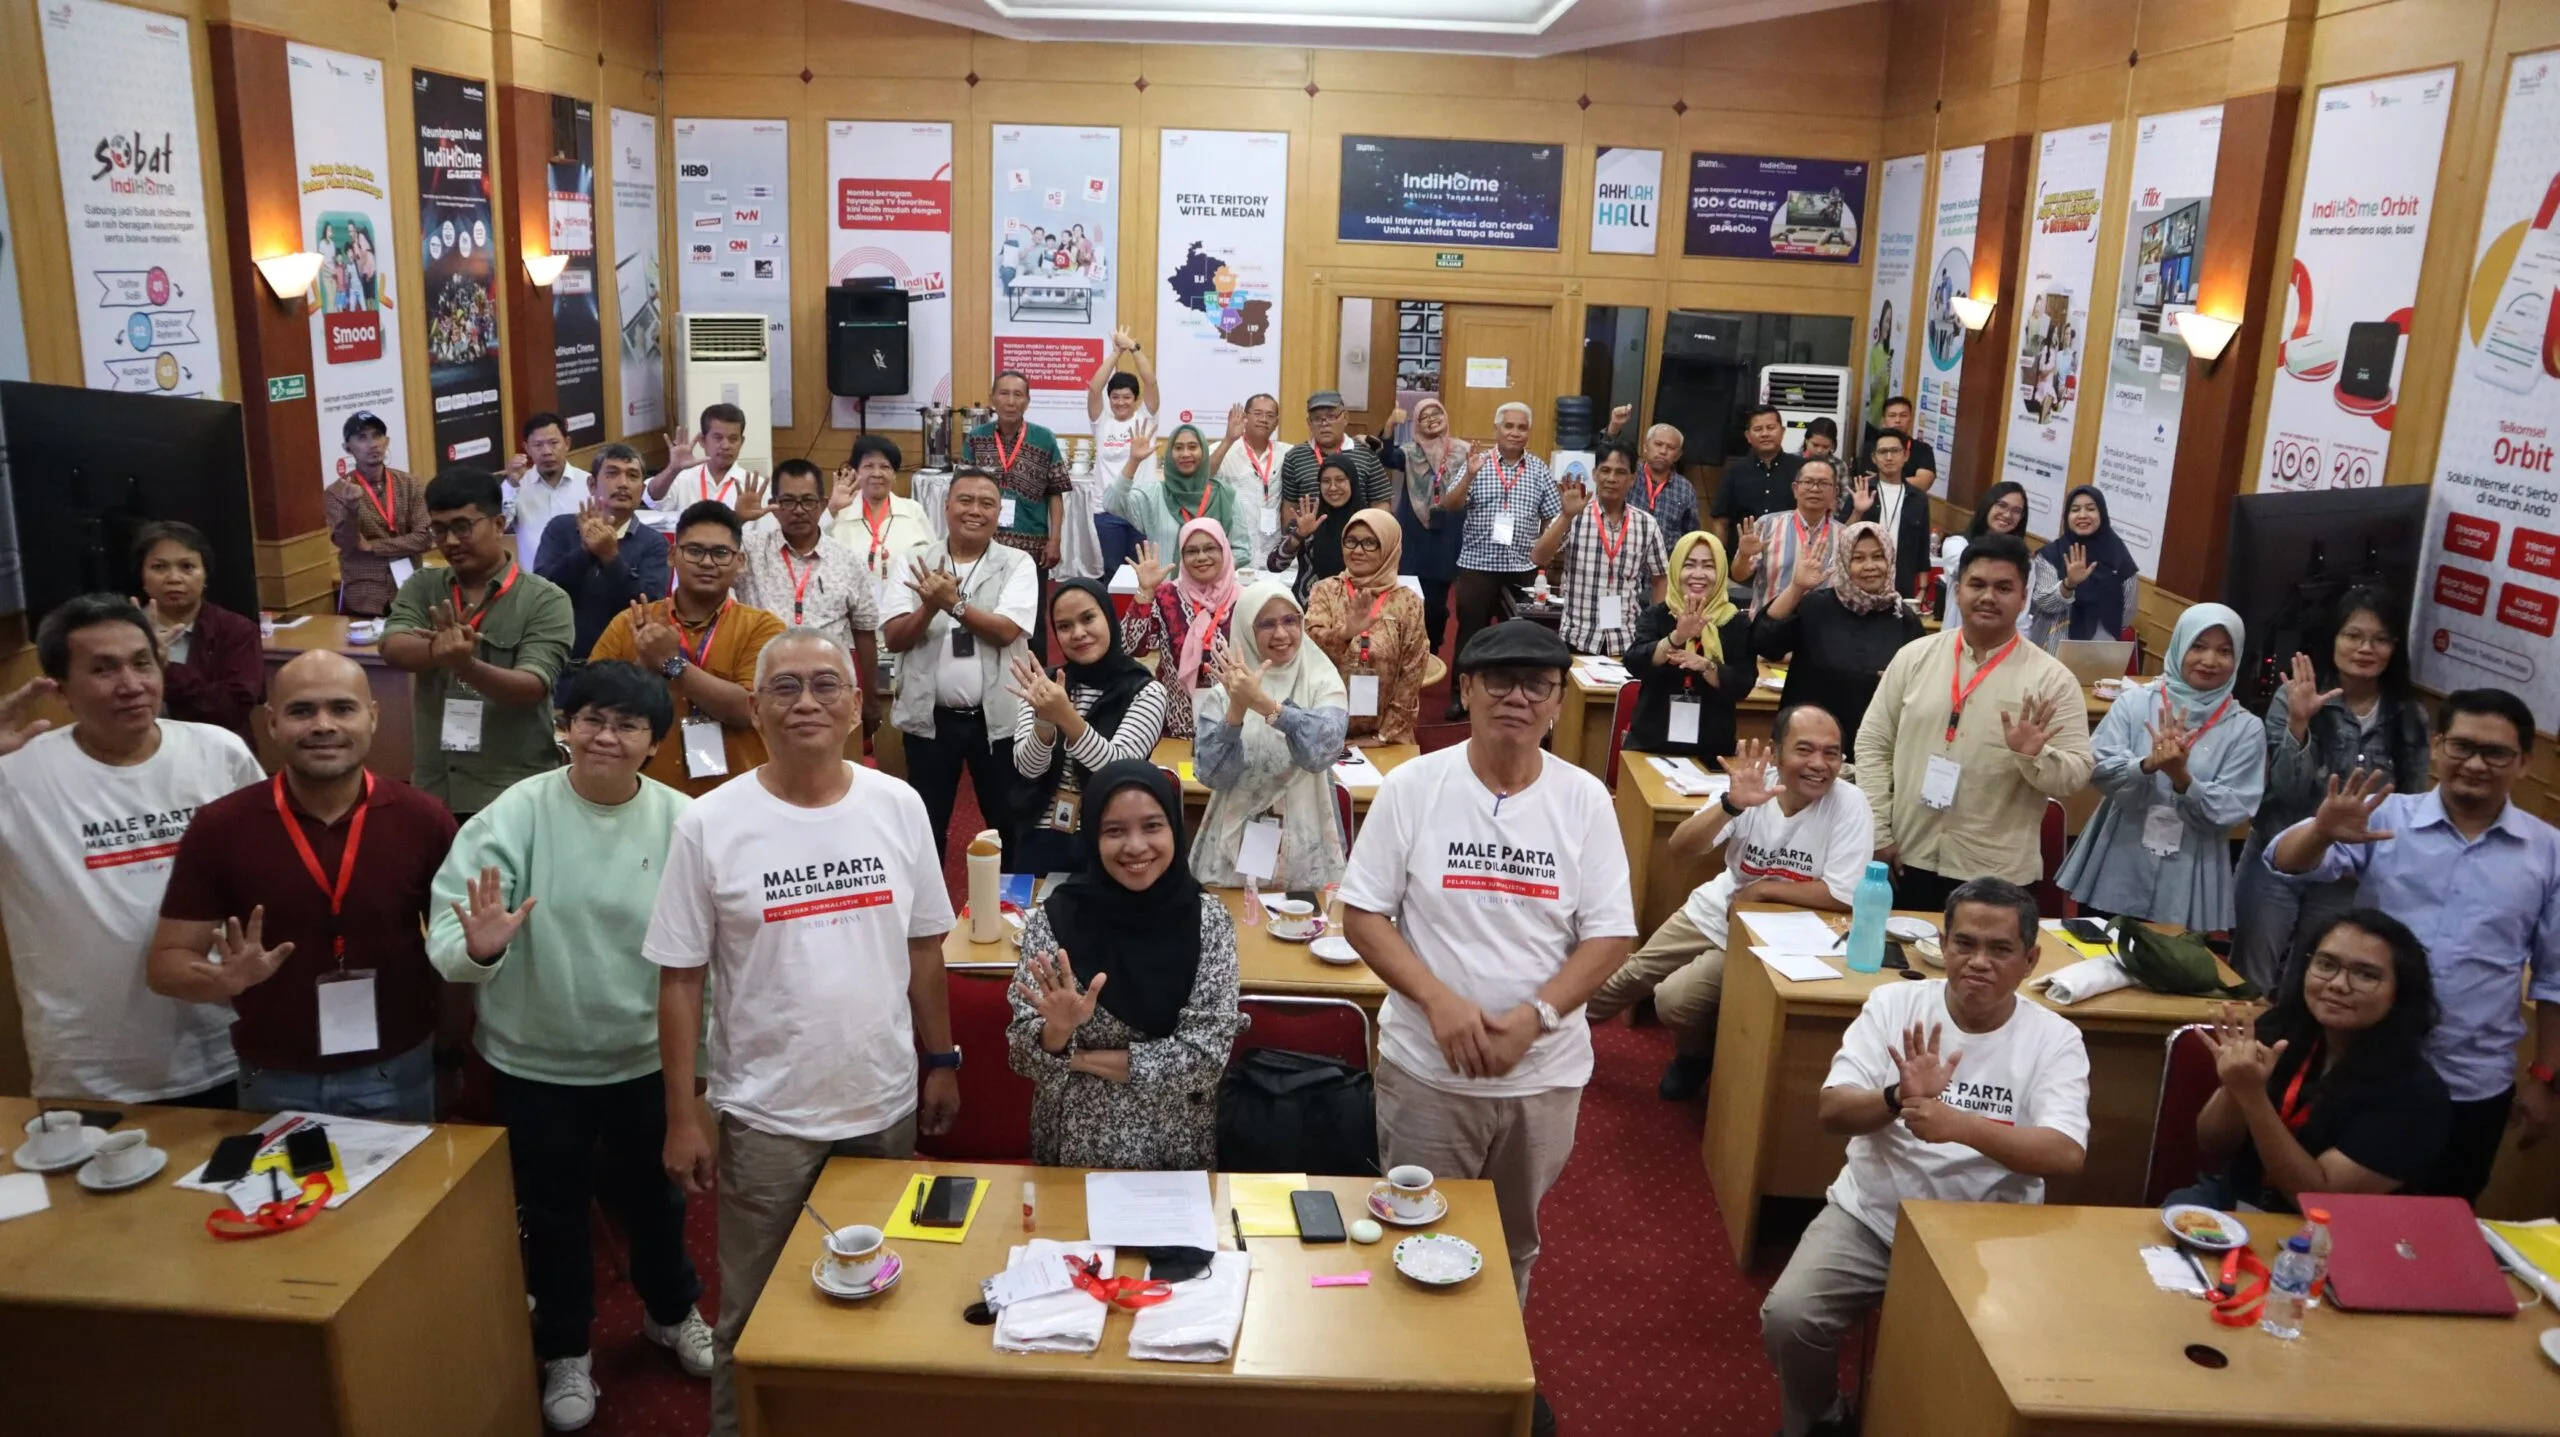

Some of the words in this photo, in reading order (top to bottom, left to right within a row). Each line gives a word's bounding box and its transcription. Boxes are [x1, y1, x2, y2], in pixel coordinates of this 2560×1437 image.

[421, 126, 463, 141] Keuntungan
[464, 128, 482, 140] Pakai
[91, 131, 172, 181] Sobat
[424, 145, 482, 168] IndiHome
[682, 164, 709, 177] HBO
[110, 177, 175, 195] IndiHome
[1404, 172, 1499, 192] IndiHome
[876, 190, 912, 198] beragam
[1176, 194, 1206, 204] PETA
[1210, 194, 1269, 206] TERITORY
[1403, 192, 1443, 200] Aktivitas
[1446, 194, 1472, 203] Tanpa
[1600, 184, 1654, 201] AKHLAK
[84, 204, 117, 216] Gabung
[134, 206, 155, 216] Sobat
[847, 198, 884, 206] tayangan
[898, 198, 935, 206] favoritmu
[883, 206, 910, 214] mudah
[1693, 196, 1725, 208] 100+
[1728, 197, 1775, 212] Games
[2312, 198, 2379, 218] IndiHome
[2381, 196, 2420, 217] Orbit
[735, 210, 759, 222] tvN
[1180, 206, 1217, 216] WITEL
[1221, 207, 1265, 218] MEDAN
[1598, 203, 1650, 228] HALL
[85, 220, 100, 229] dan
[119, 221, 151, 231] beragam
[1366, 216, 1393, 225] Solusi
[1395, 216, 1433, 226] Internet
[1436, 218, 1477, 229] Berkelas
[1479, 220, 1498, 229] dan
[1500, 221, 1534, 231] Cerdas
[2347, 225, 2375, 235] dimana
[1384, 226, 1411, 235] Untuk
[1414, 226, 1454, 237] Aktivitas
[1456, 229, 1486, 239] Tanpa
[1488, 230, 1515, 239] Batas
[694, 245, 712, 253] HBO
[730, 240, 748, 251] CNN
[332, 326, 376, 344] Smooa
[2500, 420, 2547, 438] Telkomsel
[2273, 440, 2321, 481] 100
[2494, 438, 2554, 473] Orbit
[2332, 452, 2371, 489] 20
[2447, 472, 2473, 483] Solusi
[2527, 487, 2557, 503] Serba
[2476, 493, 2485, 504] di
[2488, 495, 2521, 511] Rumah
[2524, 503, 2551, 518] Anda
[82, 817, 139, 838] MALE
[144, 808, 193, 828] PART
[86, 836, 123, 850] MALE
[1448, 842, 1497, 859] MALE
[1502, 846, 1556, 867] PARTA
[764, 865, 817, 888] MALE
[824, 856, 884, 878] PARTA
[1448, 860, 1482, 870] MALE
[1484, 861, 1556, 880] DILABUNTUR
[766, 886, 802, 902] MALE
[806, 874, 887, 895] DILABUNTUR
[1446, 879, 1486, 887] PELATIHAN
[768, 906, 809, 919] PELATIHAN
[811, 898, 859, 911] JURNALISTIK
[1958, 1082, 2013, 1103] PARTA
